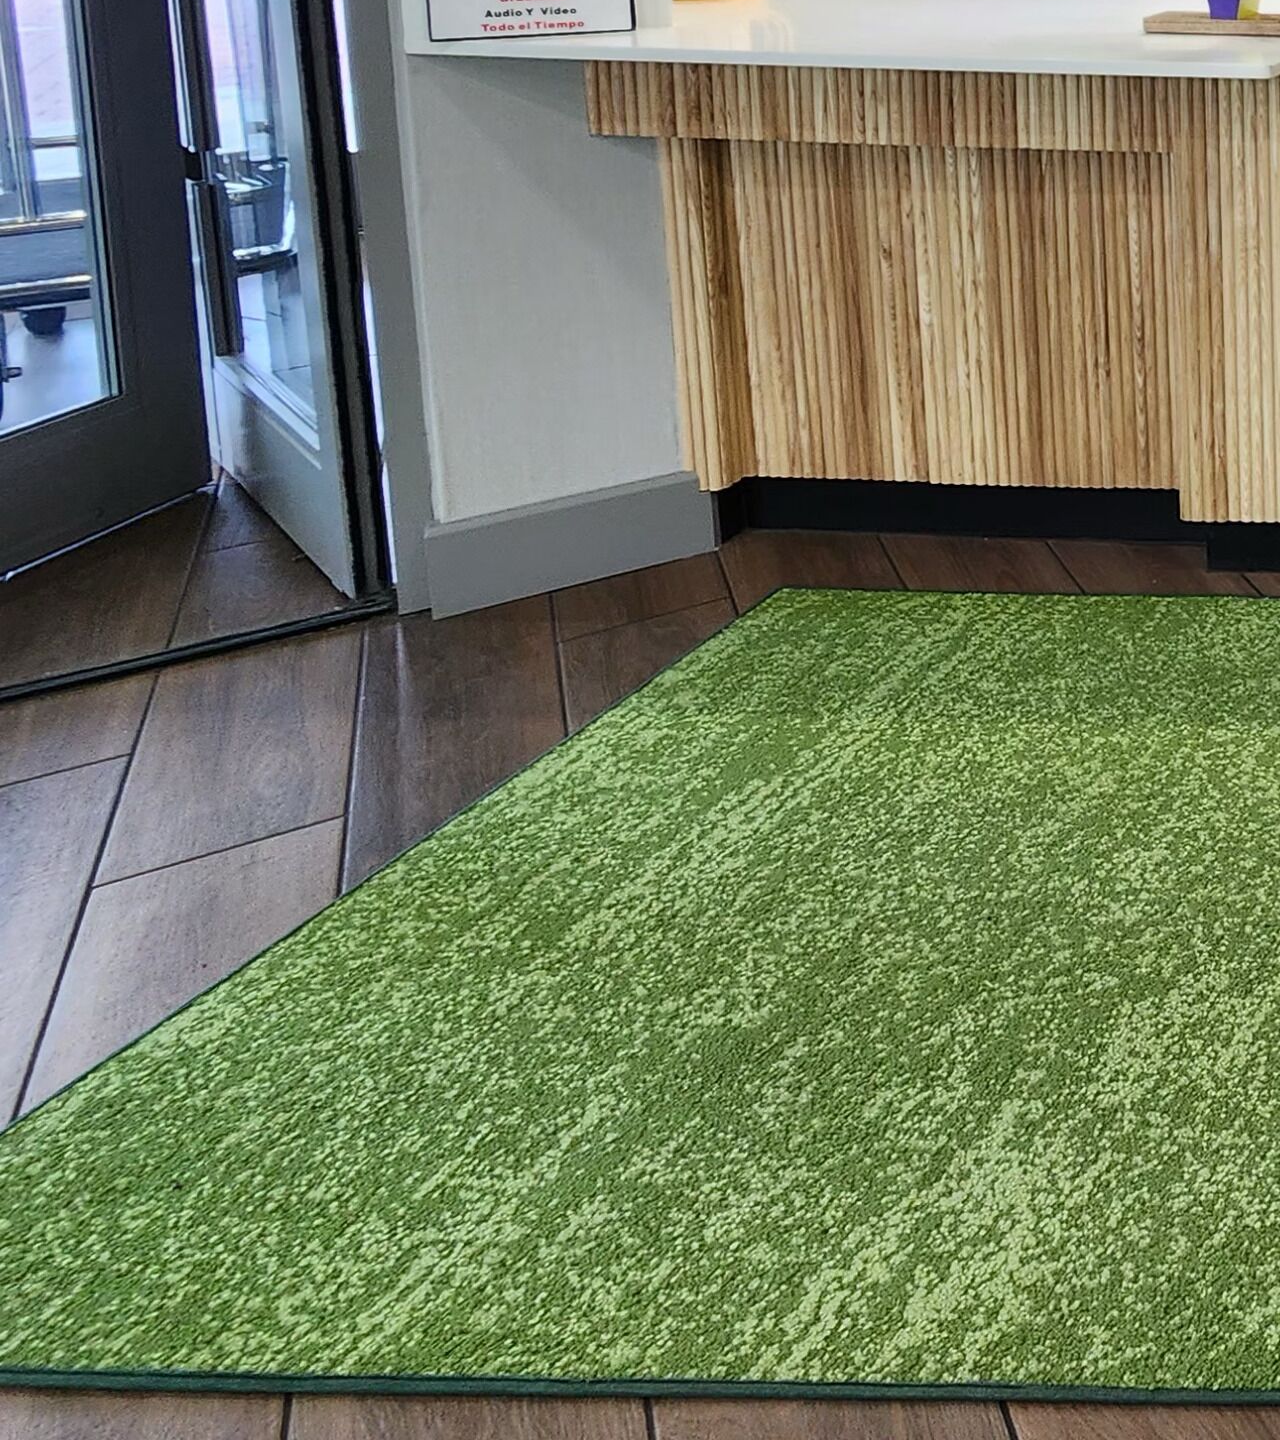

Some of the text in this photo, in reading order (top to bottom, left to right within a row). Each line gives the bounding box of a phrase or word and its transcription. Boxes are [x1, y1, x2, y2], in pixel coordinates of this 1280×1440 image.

[485, 6, 577, 18] Audio Y Video
[481, 20, 585, 32] Todo el Tiempo
